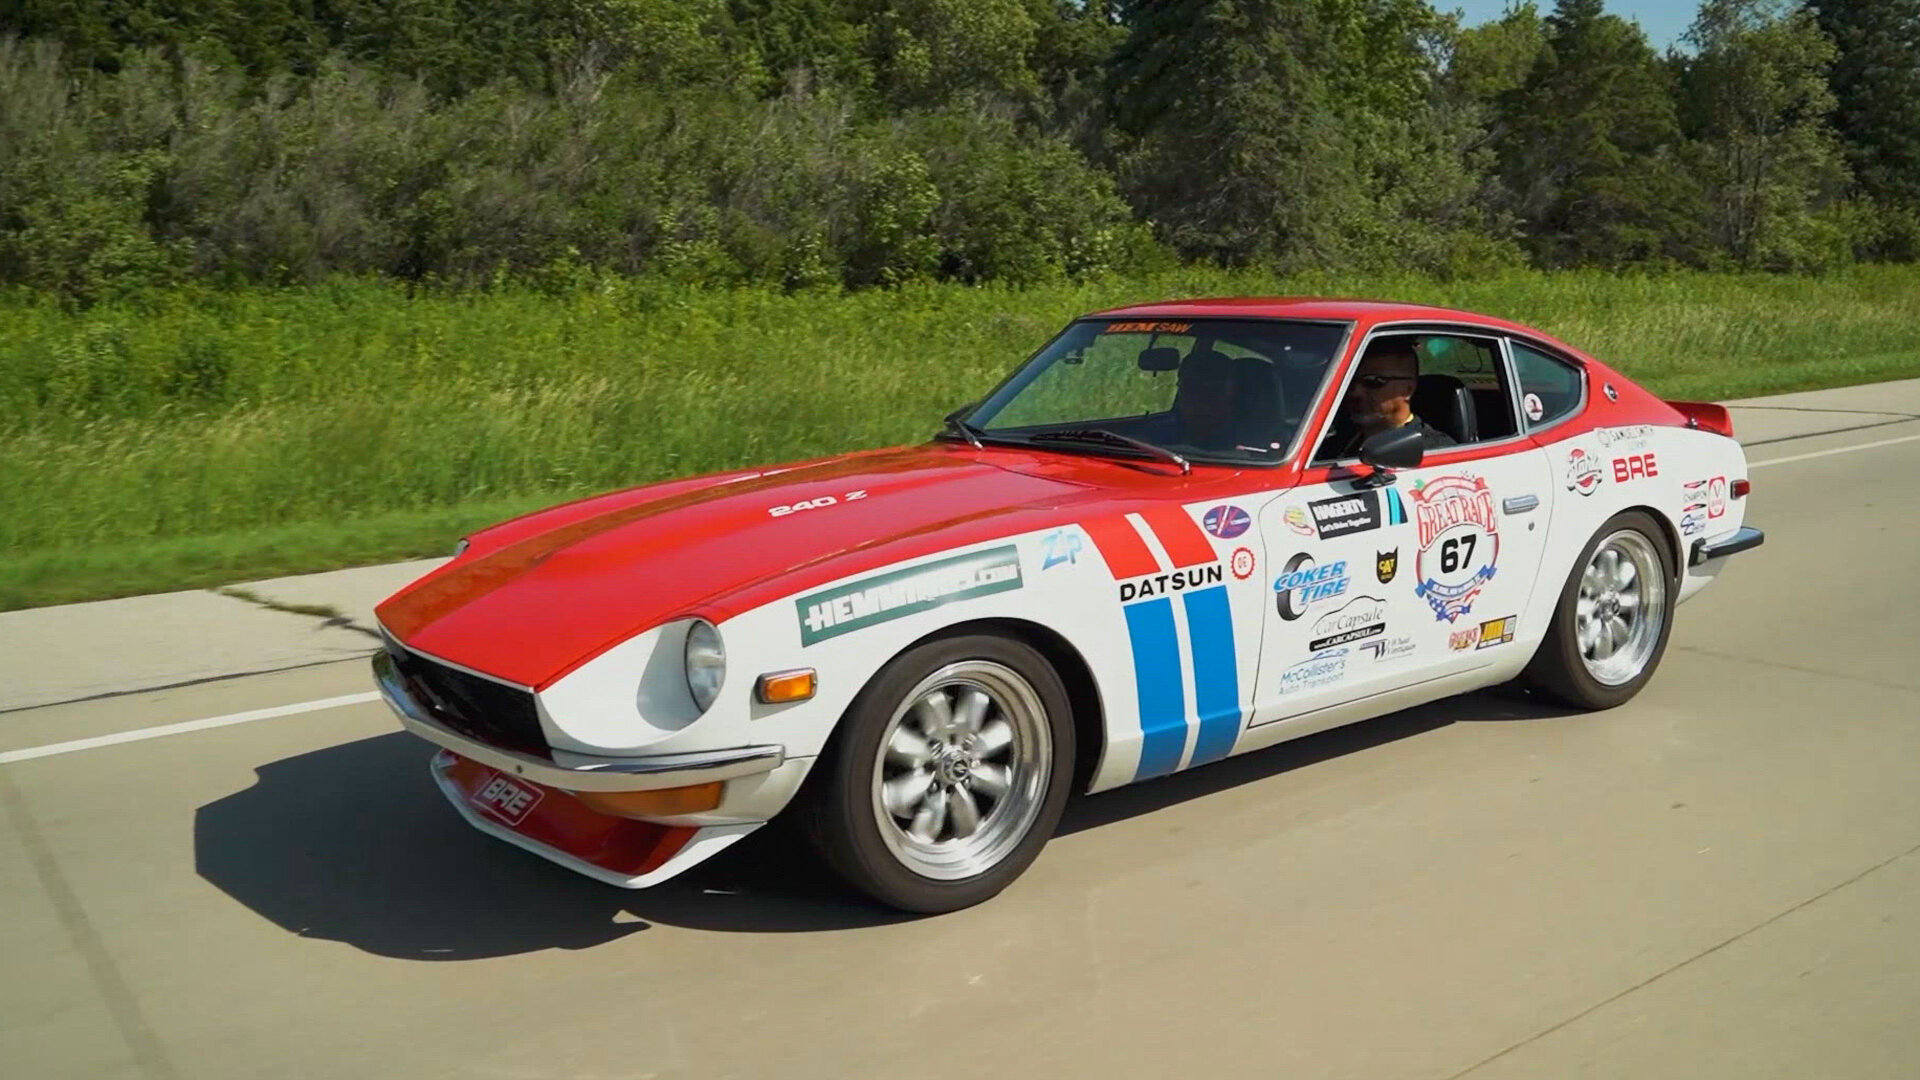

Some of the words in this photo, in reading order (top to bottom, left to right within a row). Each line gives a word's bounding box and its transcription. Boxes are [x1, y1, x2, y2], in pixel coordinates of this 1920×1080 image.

[1156, 322, 1194, 334] SAW
[1613, 453, 1658, 483] BRE
[768, 495, 838, 517] 240
[844, 489, 868, 501] Z
[1312, 499, 1368, 521] HAGERTY
[1417, 499, 1460, 549] GREAT
[1462, 489, 1497, 533] RACE
[1378, 558, 1396, 574] CAT
[1441, 534, 1477, 574] 67
[1120, 565, 1222, 602] DATSUN
[1273, 560, 1347, 592] COKER
[1300, 577, 1351, 604] TIRE
[481, 778, 533, 816] BRE
